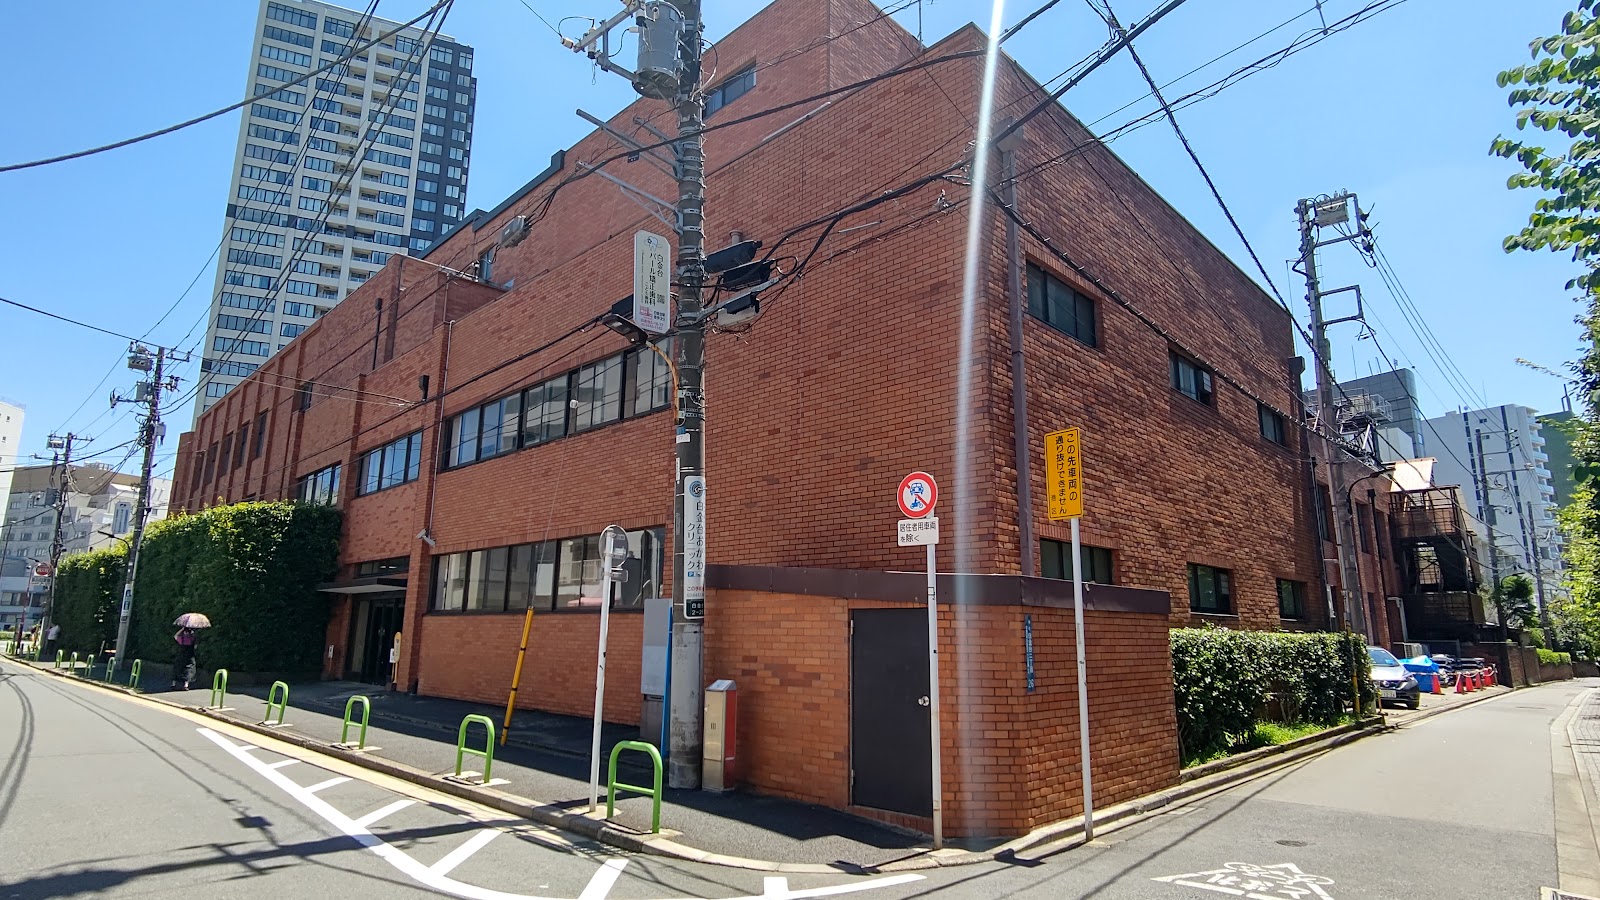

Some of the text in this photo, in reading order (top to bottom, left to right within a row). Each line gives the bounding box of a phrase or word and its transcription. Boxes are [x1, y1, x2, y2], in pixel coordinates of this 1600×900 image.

[1055, 435, 1067, 515] 通り抜けできません
[1066, 433, 1078, 501] この先車両の
[687, 522, 696, 570] クリニック
[696, 501, 704, 570] 白金台おがわ
[900, 521, 936, 532] 居住者用車両
[900, 533, 920, 543] を除く
